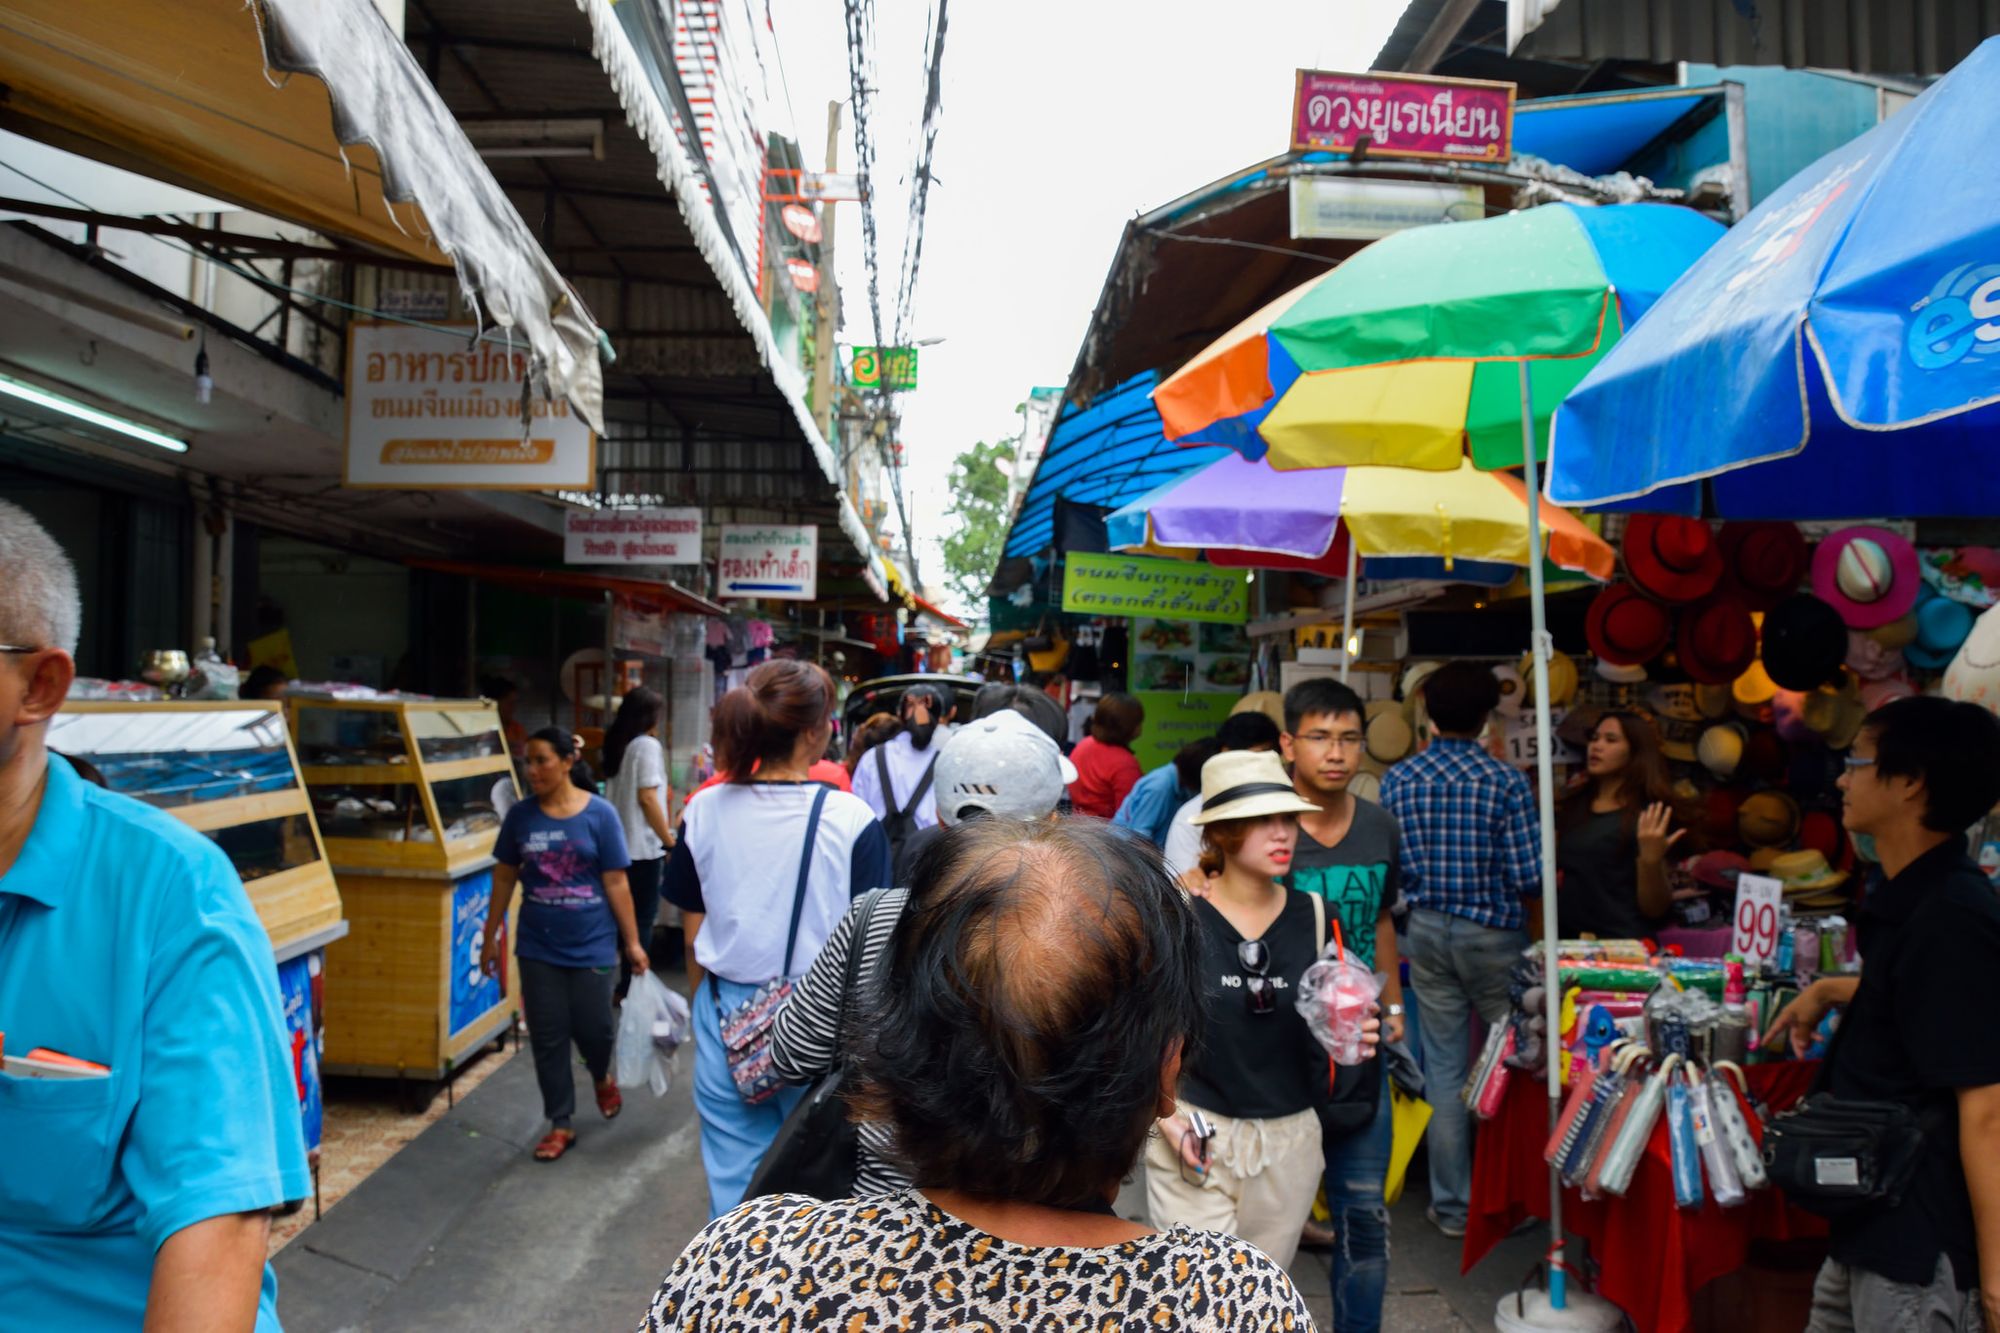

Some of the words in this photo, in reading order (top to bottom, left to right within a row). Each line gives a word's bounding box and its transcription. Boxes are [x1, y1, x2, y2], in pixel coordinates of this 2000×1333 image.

[1307, 90, 1500, 144] ดวงยูเรเนียน
[722, 548, 811, 580] รองเท้าเด็ก
[1737, 899, 1776, 958] 99
[1221, 974, 1242, 988] NO
